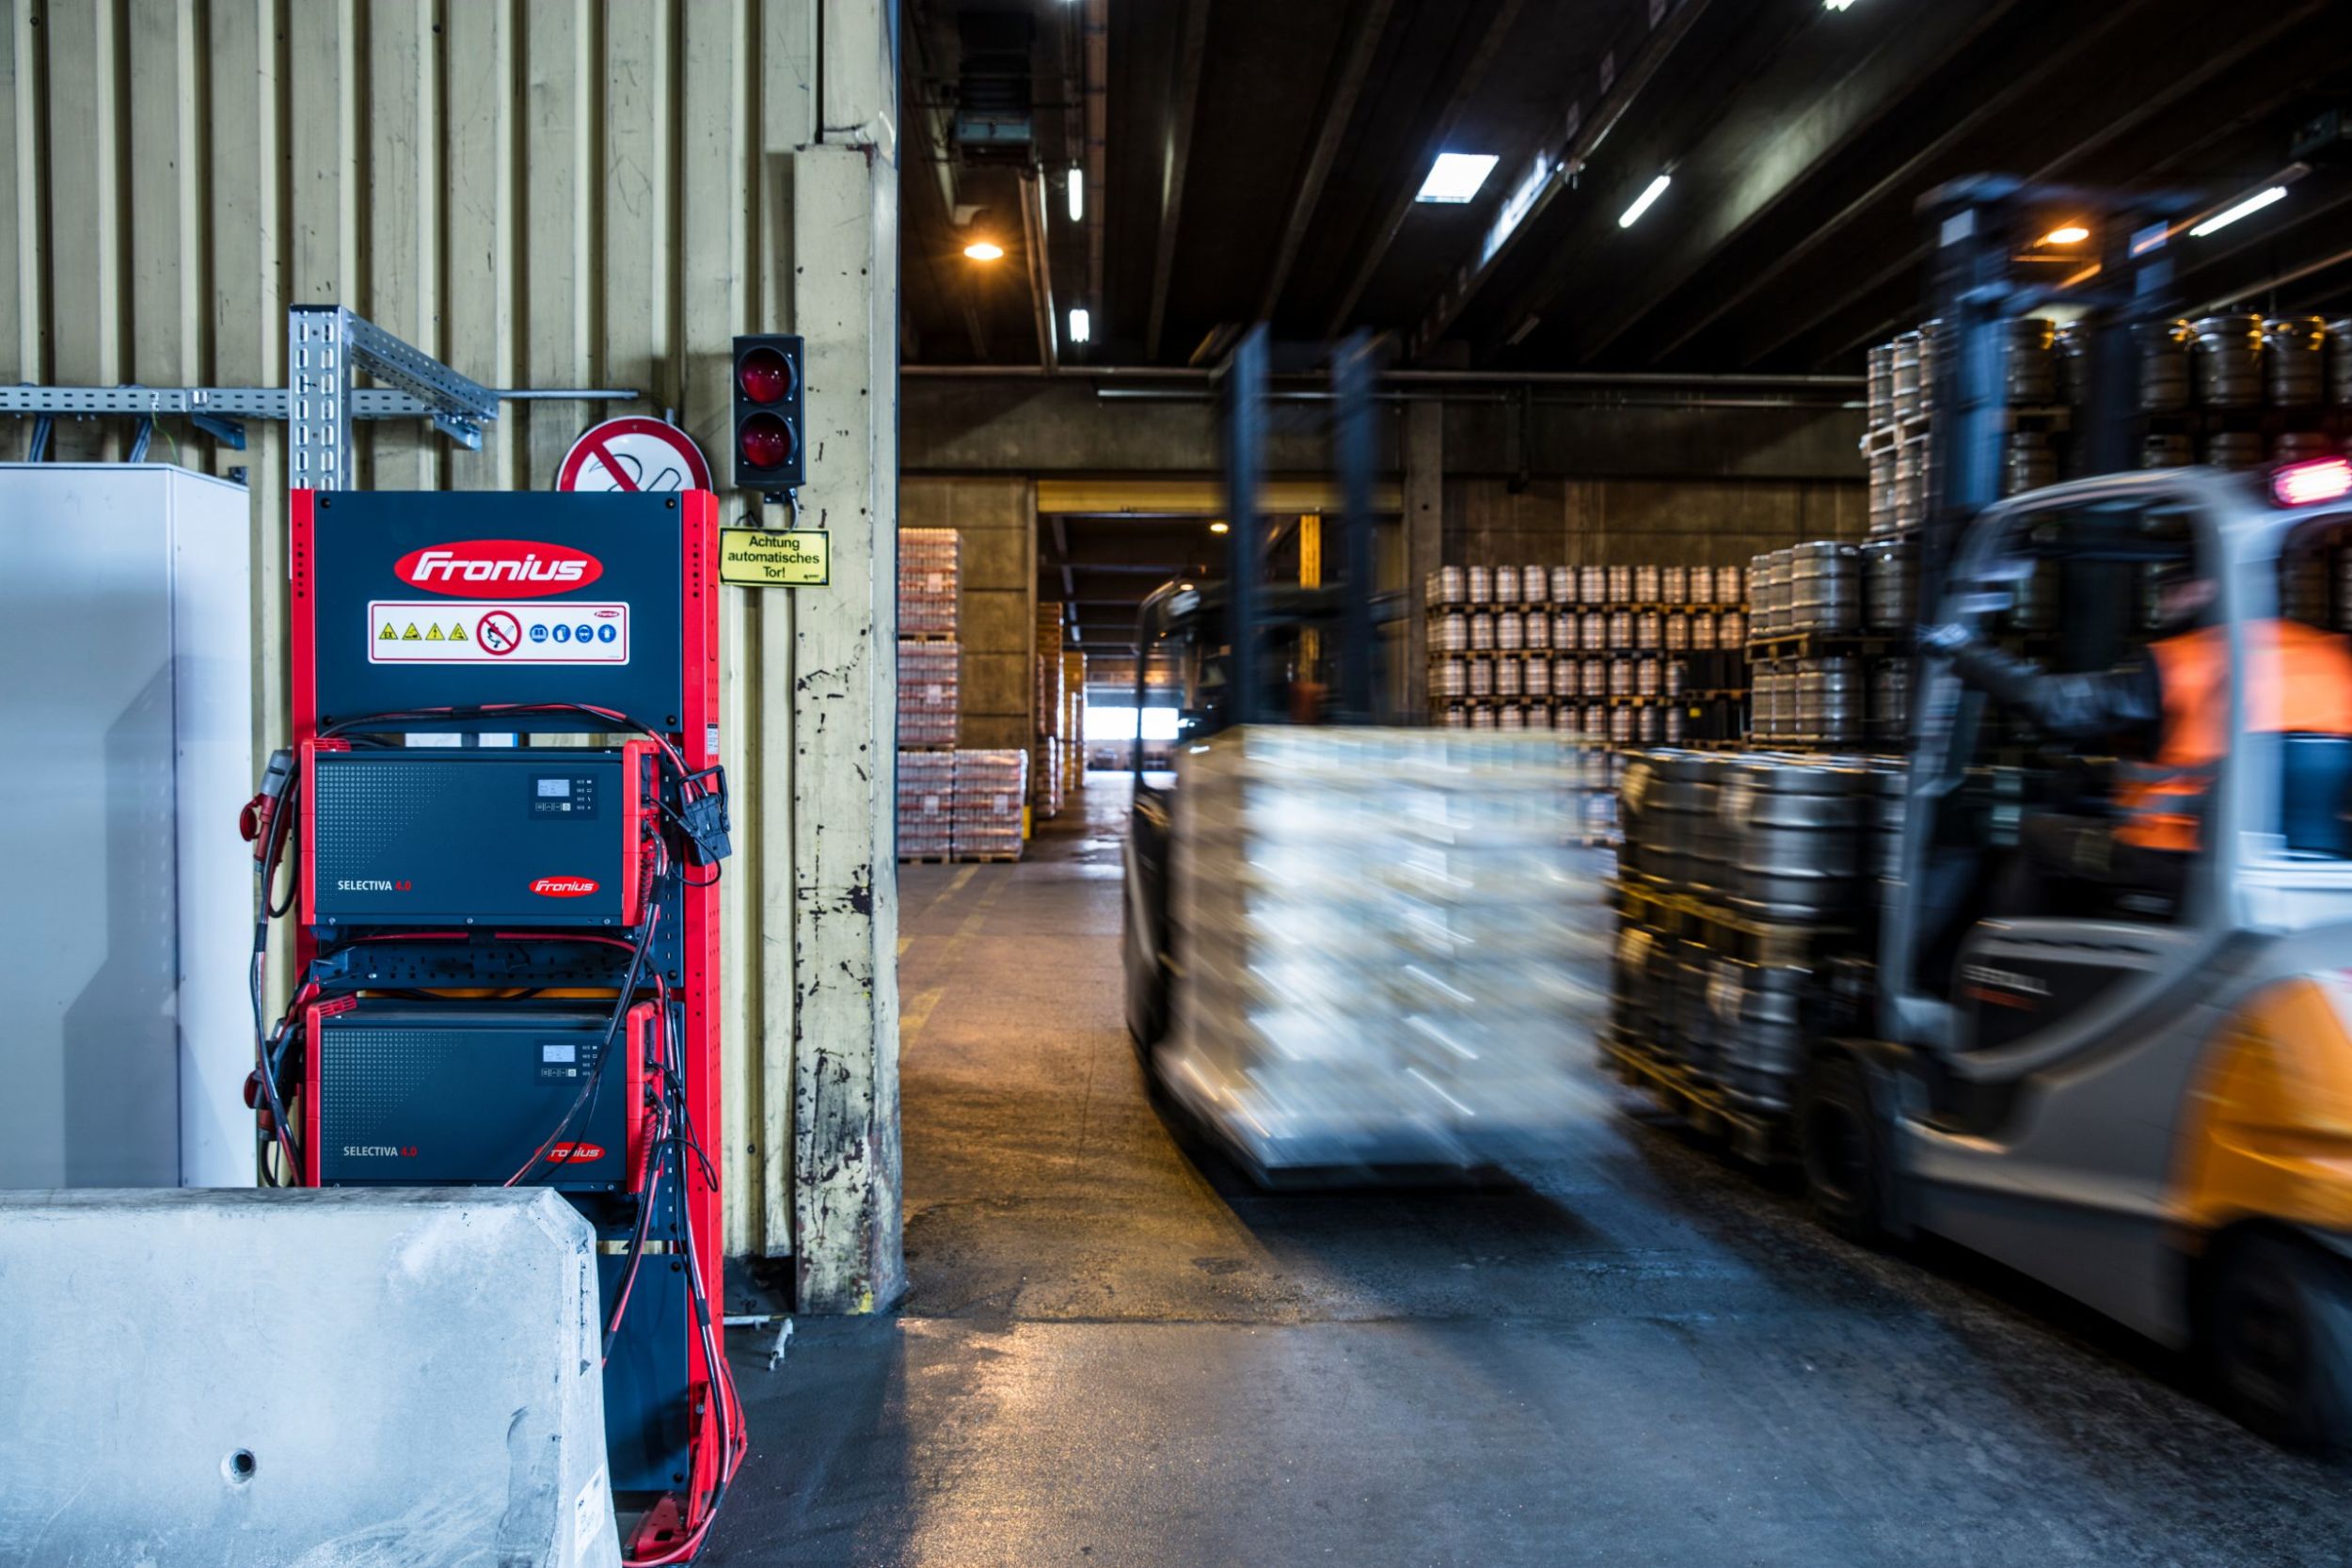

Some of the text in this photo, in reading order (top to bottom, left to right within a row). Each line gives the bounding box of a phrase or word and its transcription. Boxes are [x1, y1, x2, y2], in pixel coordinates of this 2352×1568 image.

[749, 535, 800, 550] Achtung
[728, 552, 819, 563] automatisches
[412, 551, 587, 580] Fronius
[763, 566, 786, 578] Tor!
[338, 880, 411, 891] SELECTIVA 4.0
[535, 880, 594, 892] Fronius
[343, 1146, 418, 1157] SELECTIVA 4.0
[548, 1146, 599, 1157] roius
